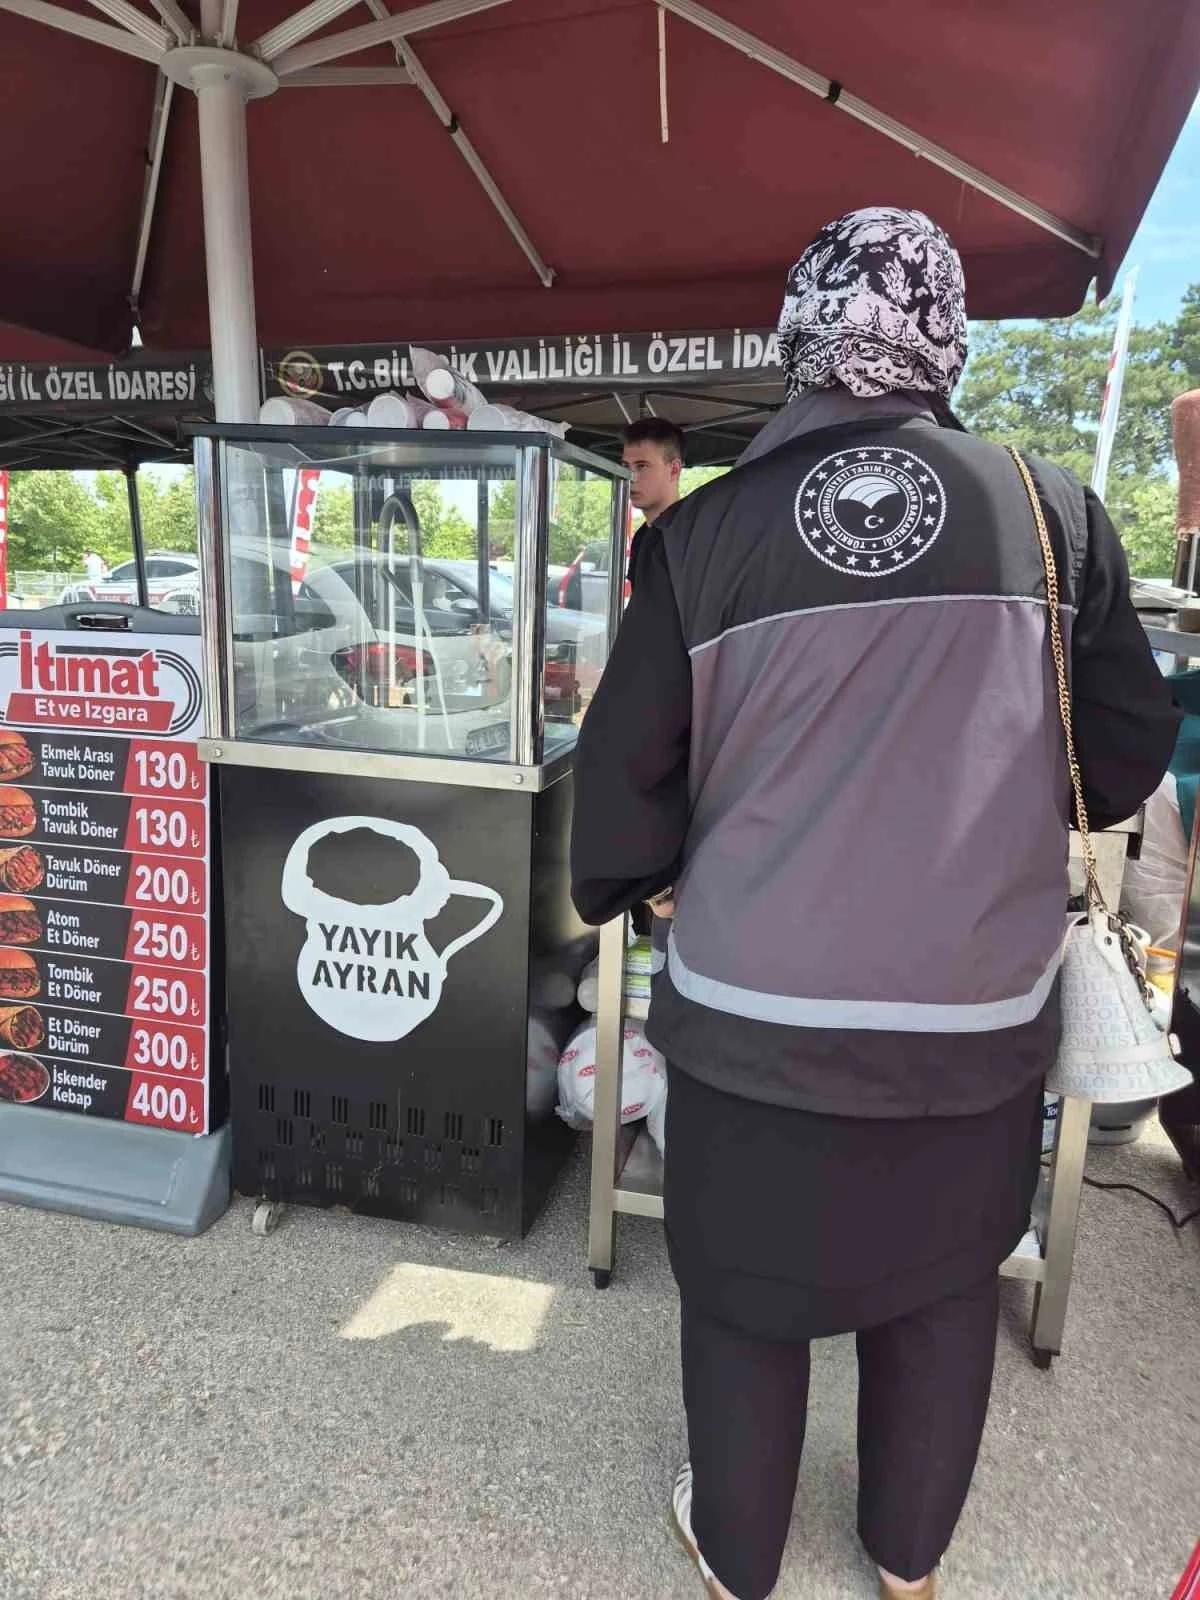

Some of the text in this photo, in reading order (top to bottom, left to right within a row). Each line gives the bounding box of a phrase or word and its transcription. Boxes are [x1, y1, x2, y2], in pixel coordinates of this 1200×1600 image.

[486, 335, 603, 382] VALİLİĞİ
[613, 334, 639, 376] İL
[648, 332, 723, 373] ÖZEL
[20, 366, 42, 401] İL
[45, 366, 103, 401] ÖZEL
[108, 363, 196, 401] İDARESİ
[829, 524, 866, 549] TÜRKİYE
[851, 464, 882, 475] TARIM
[885, 467, 897, 477] VE
[896, 474, 918, 502] ORMAN
[35, 698, 148, 723] Et ve Izgara
[41, 744, 114, 764] Ekmek Arası
[41, 762, 115, 782] Tavuk Döner
[42, 800, 88, 819] Tombik
[42, 818, 118, 839] Tavuk Döner
[46, 855, 121, 877] Tavuk Döner
[46, 872, 88, 892] Dürüm
[47, 910, 80, 928] Atom
[47, 927, 100, 949] Et Döner
[318, 922, 420, 961] YAYIK
[47, 963, 94, 983] Tombik
[312, 960, 431, 1000] AYRAN
[47, 981, 102, 1003] Et Döner
[48, 1017, 101, 1039] Et Döner
[48, 1034, 89, 1055] Dürüm
[52, 1064, 107, 1092] İskender
[52, 1085, 92, 1109] Kebap
